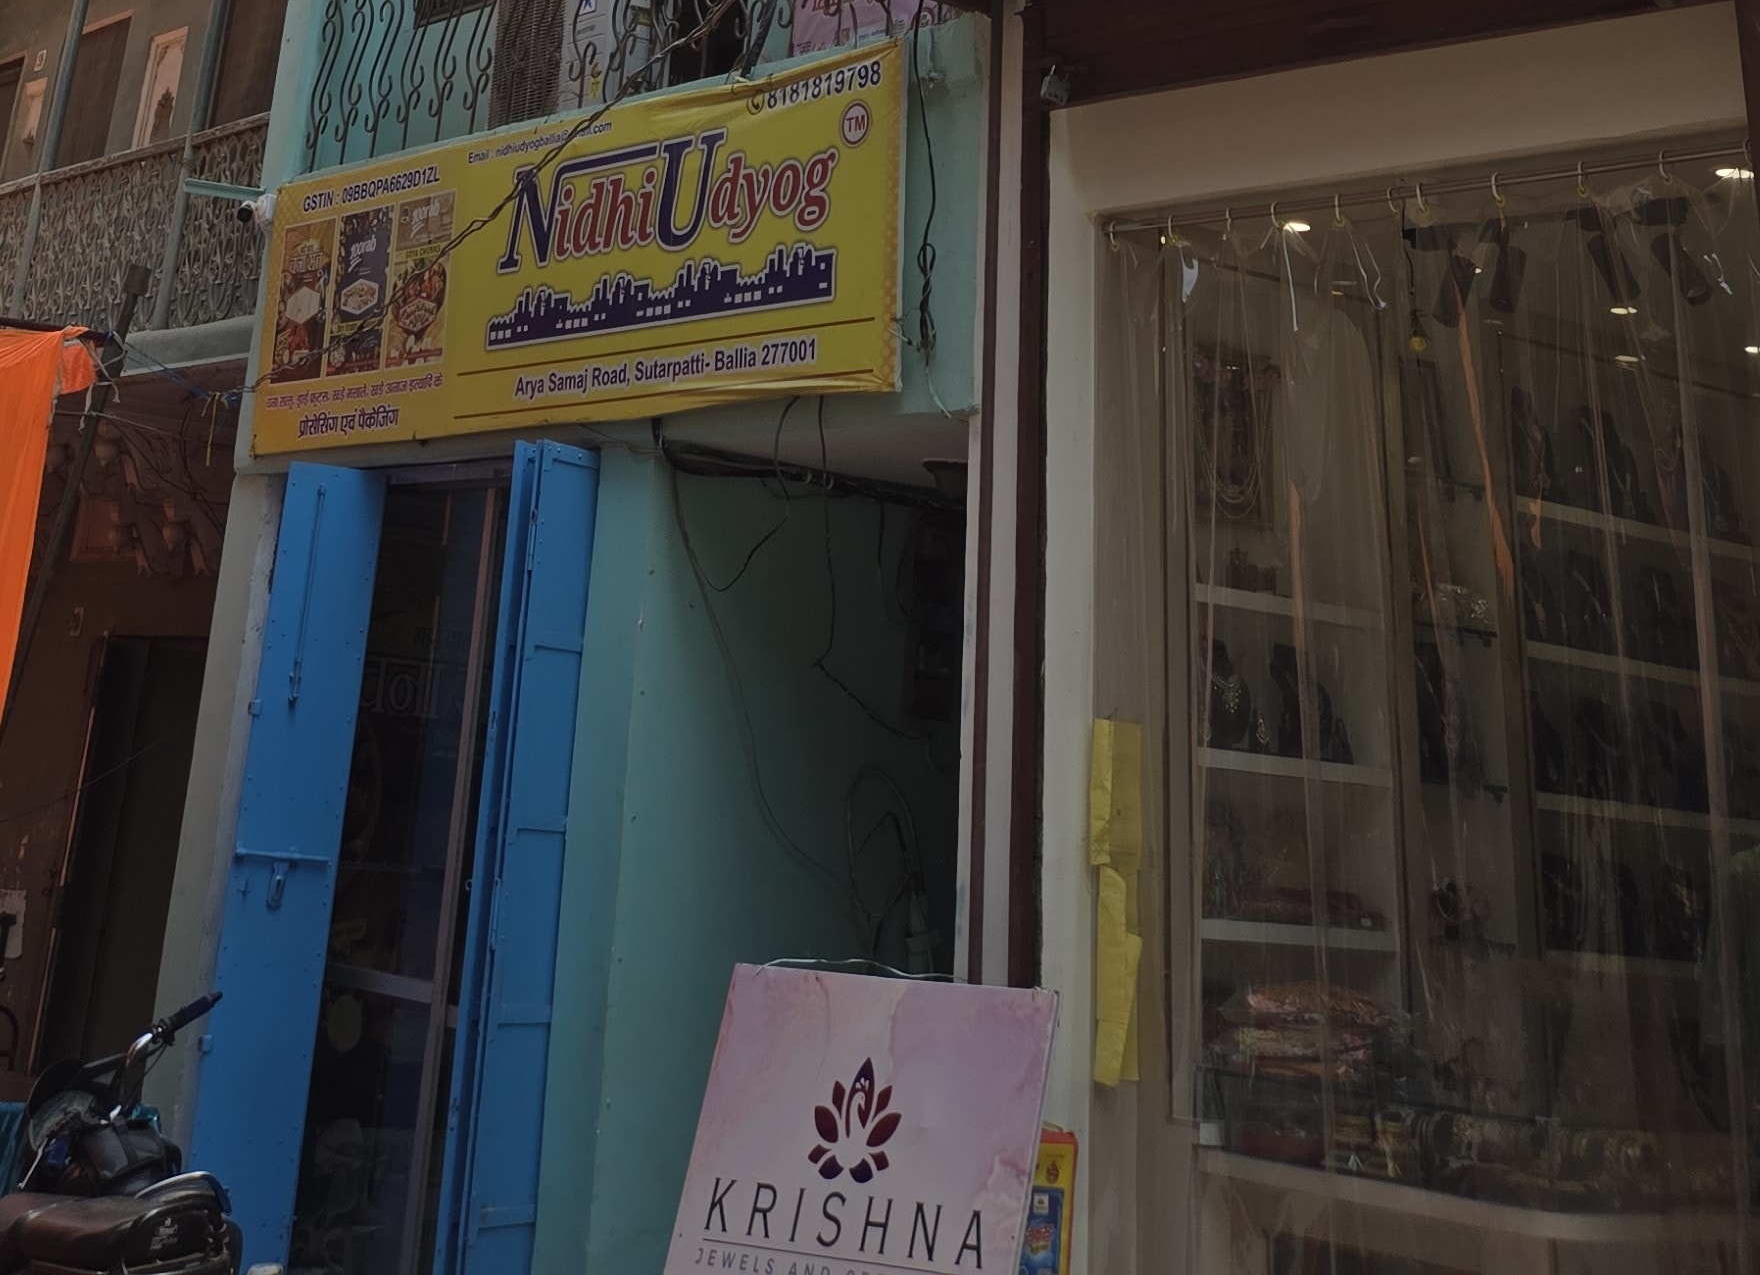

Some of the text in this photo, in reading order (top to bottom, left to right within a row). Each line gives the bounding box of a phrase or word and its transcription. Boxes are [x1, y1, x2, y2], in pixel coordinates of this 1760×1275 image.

[468, 151, 489, 164] Email
[303, 191, 335, 212] GSTIN
[514, 338, 816, 399] Arya Samaj Road, Sutarpatti- Ballia 277001
[341, 409, 358, 436] एवं
[703, 1177, 983, 1269] KRISHNA
[695, 1247, 776, 1275] JEWELS
